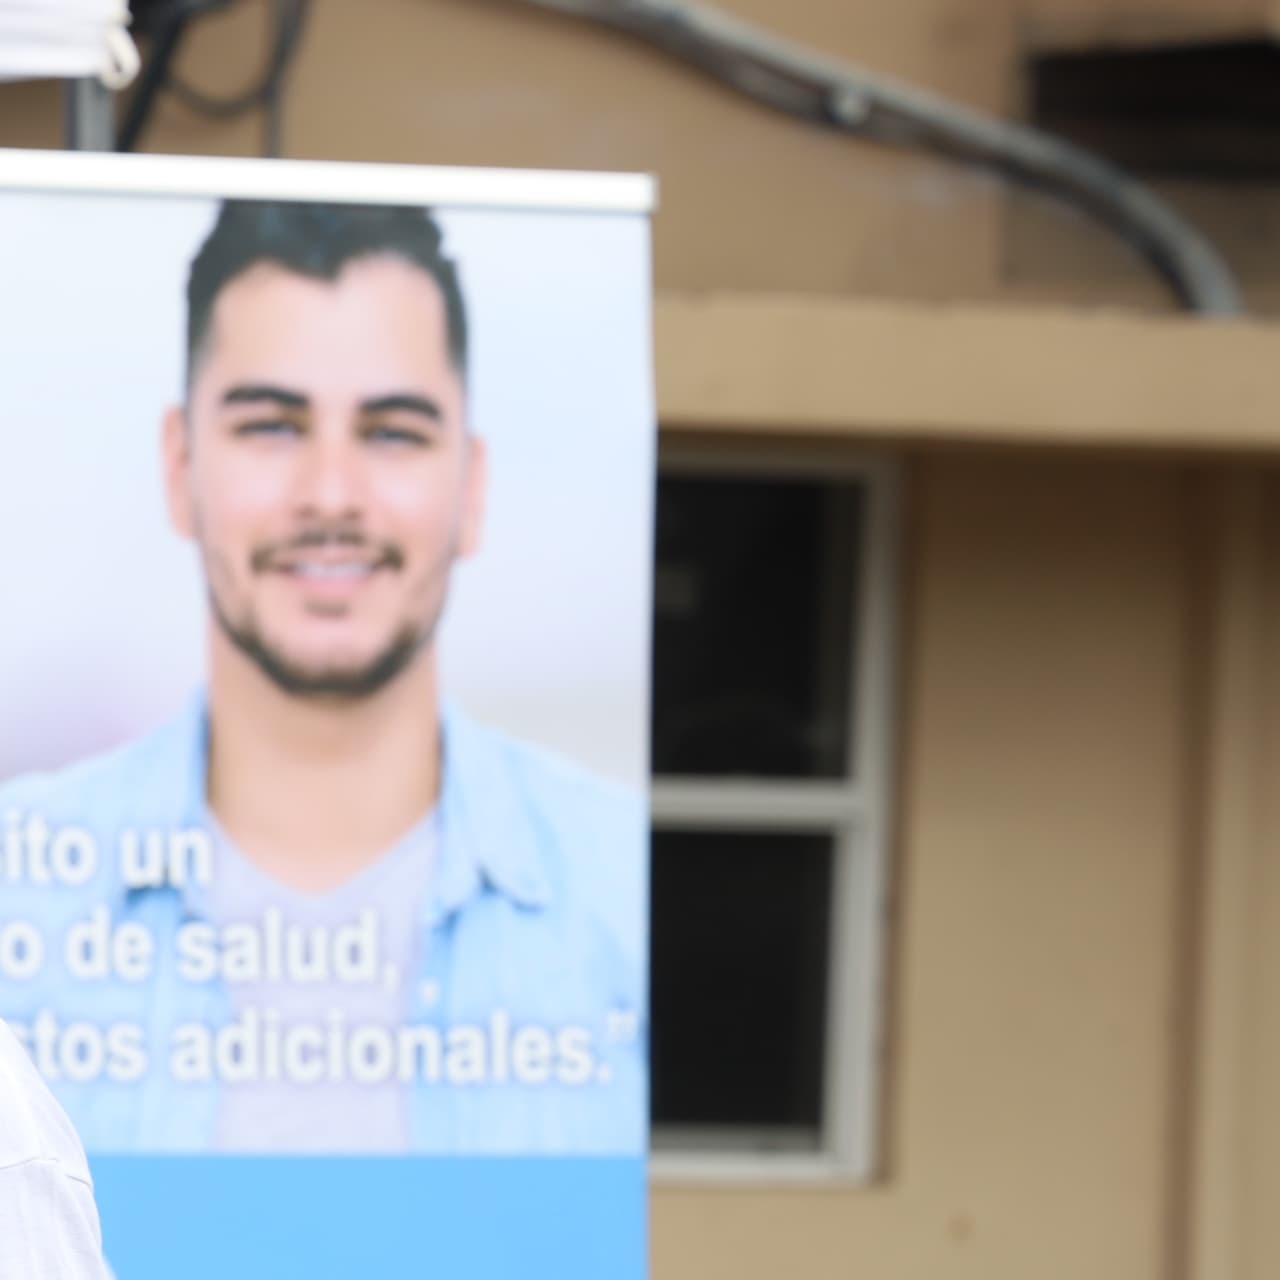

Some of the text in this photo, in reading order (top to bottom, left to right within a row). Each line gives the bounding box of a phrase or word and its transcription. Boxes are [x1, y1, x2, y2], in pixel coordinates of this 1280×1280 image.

[121, 826, 213, 881] un
[66, 905, 156, 980] de
[178, 905, 397, 988] salud,
